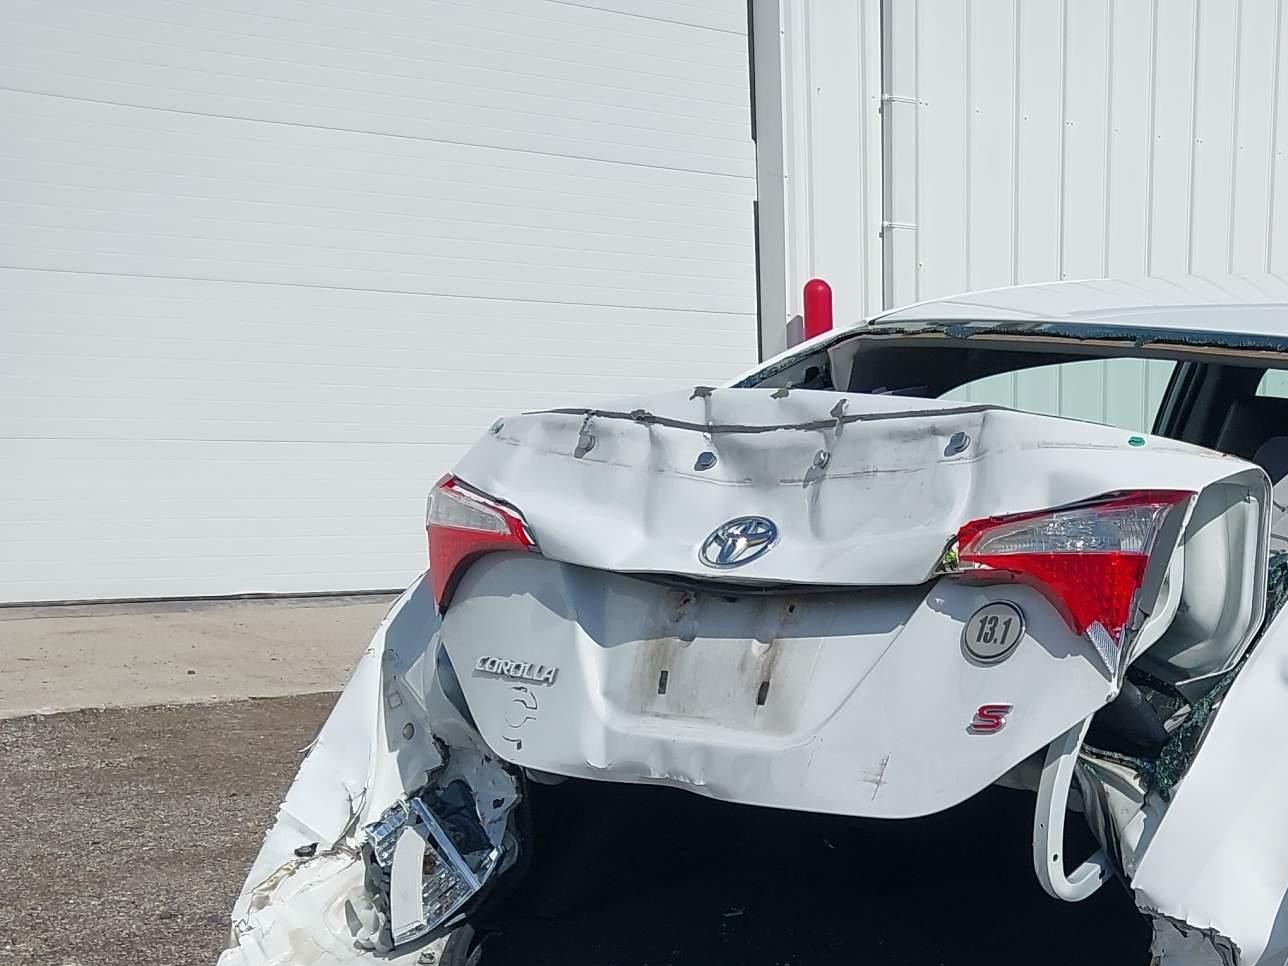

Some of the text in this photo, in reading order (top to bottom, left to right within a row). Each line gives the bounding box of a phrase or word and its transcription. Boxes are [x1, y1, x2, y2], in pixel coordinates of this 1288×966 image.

[976, 615, 1013, 645] 13.1
[474, 656, 559, 684] COROLLA
[968, 704, 1013, 734] S
